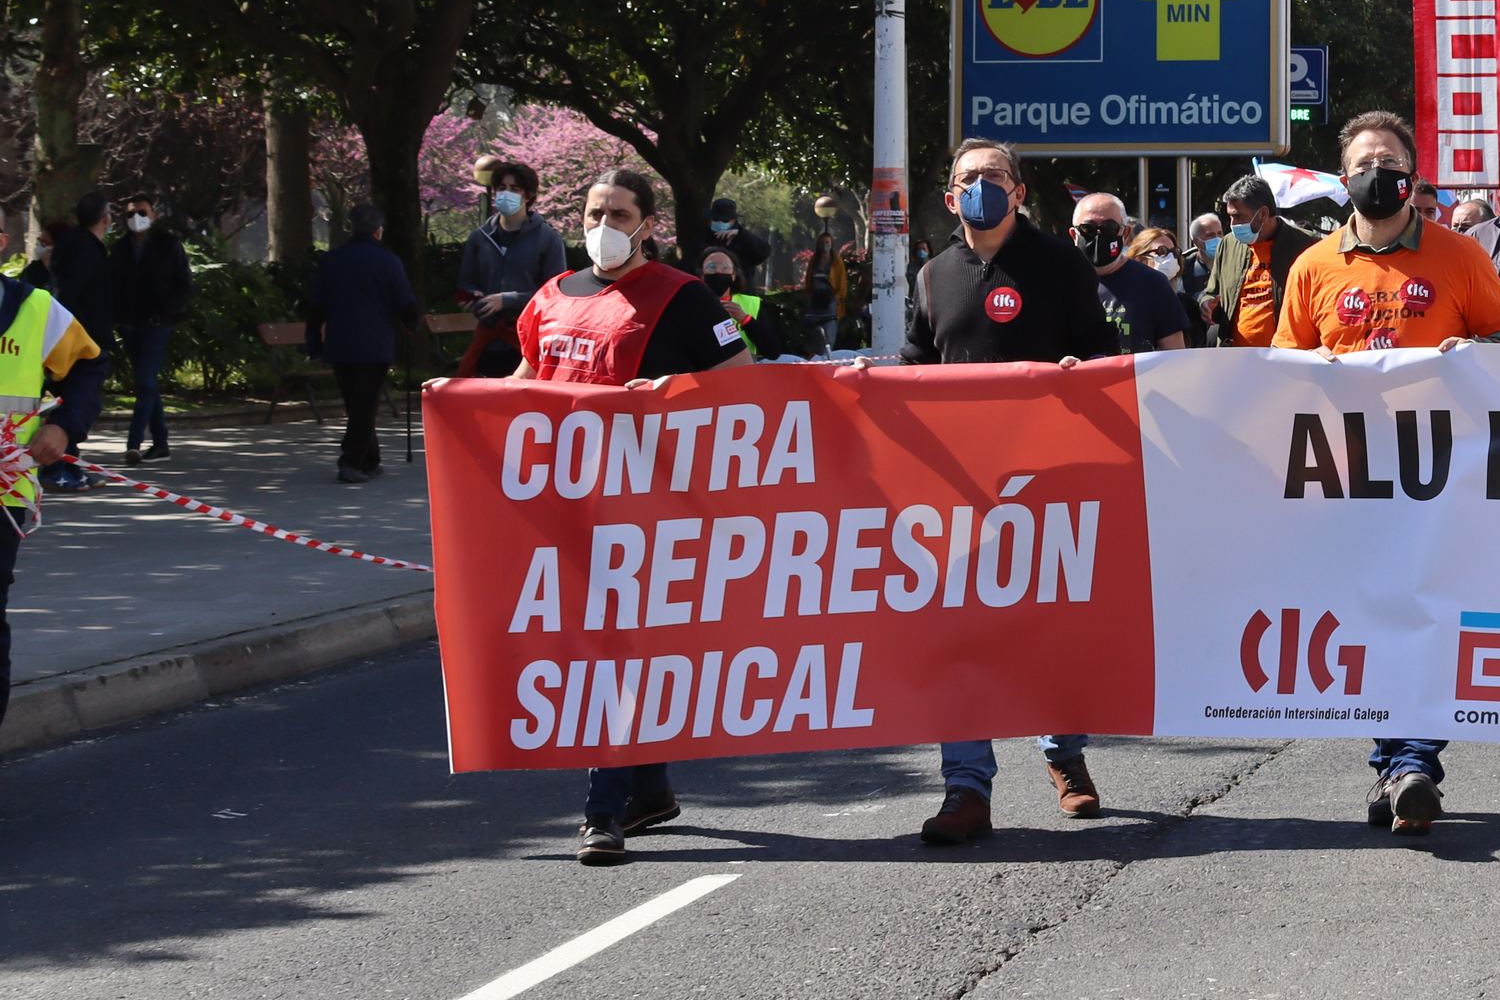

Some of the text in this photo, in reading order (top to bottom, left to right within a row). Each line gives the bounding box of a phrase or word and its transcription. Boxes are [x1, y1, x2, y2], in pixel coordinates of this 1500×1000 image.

[1167, 4, 1211, 23] MIN
[971, 93, 1263, 134] Parque Ofimático
[993, 294, 1016, 308] CIG
[1343, 296, 1365, 311] CIG
[1406, 283, 1429, 298] CIG
[501, 401, 816, 501] CONTRA
[1284, 409, 1453, 501] ALU
[508, 475, 1100, 633] A REPRESIÓN
[1240, 608, 1366, 695] CIG
[509, 641, 875, 750] SINDICAL
[1205, 705, 1389, 722] Confederación Intersindical Galega
